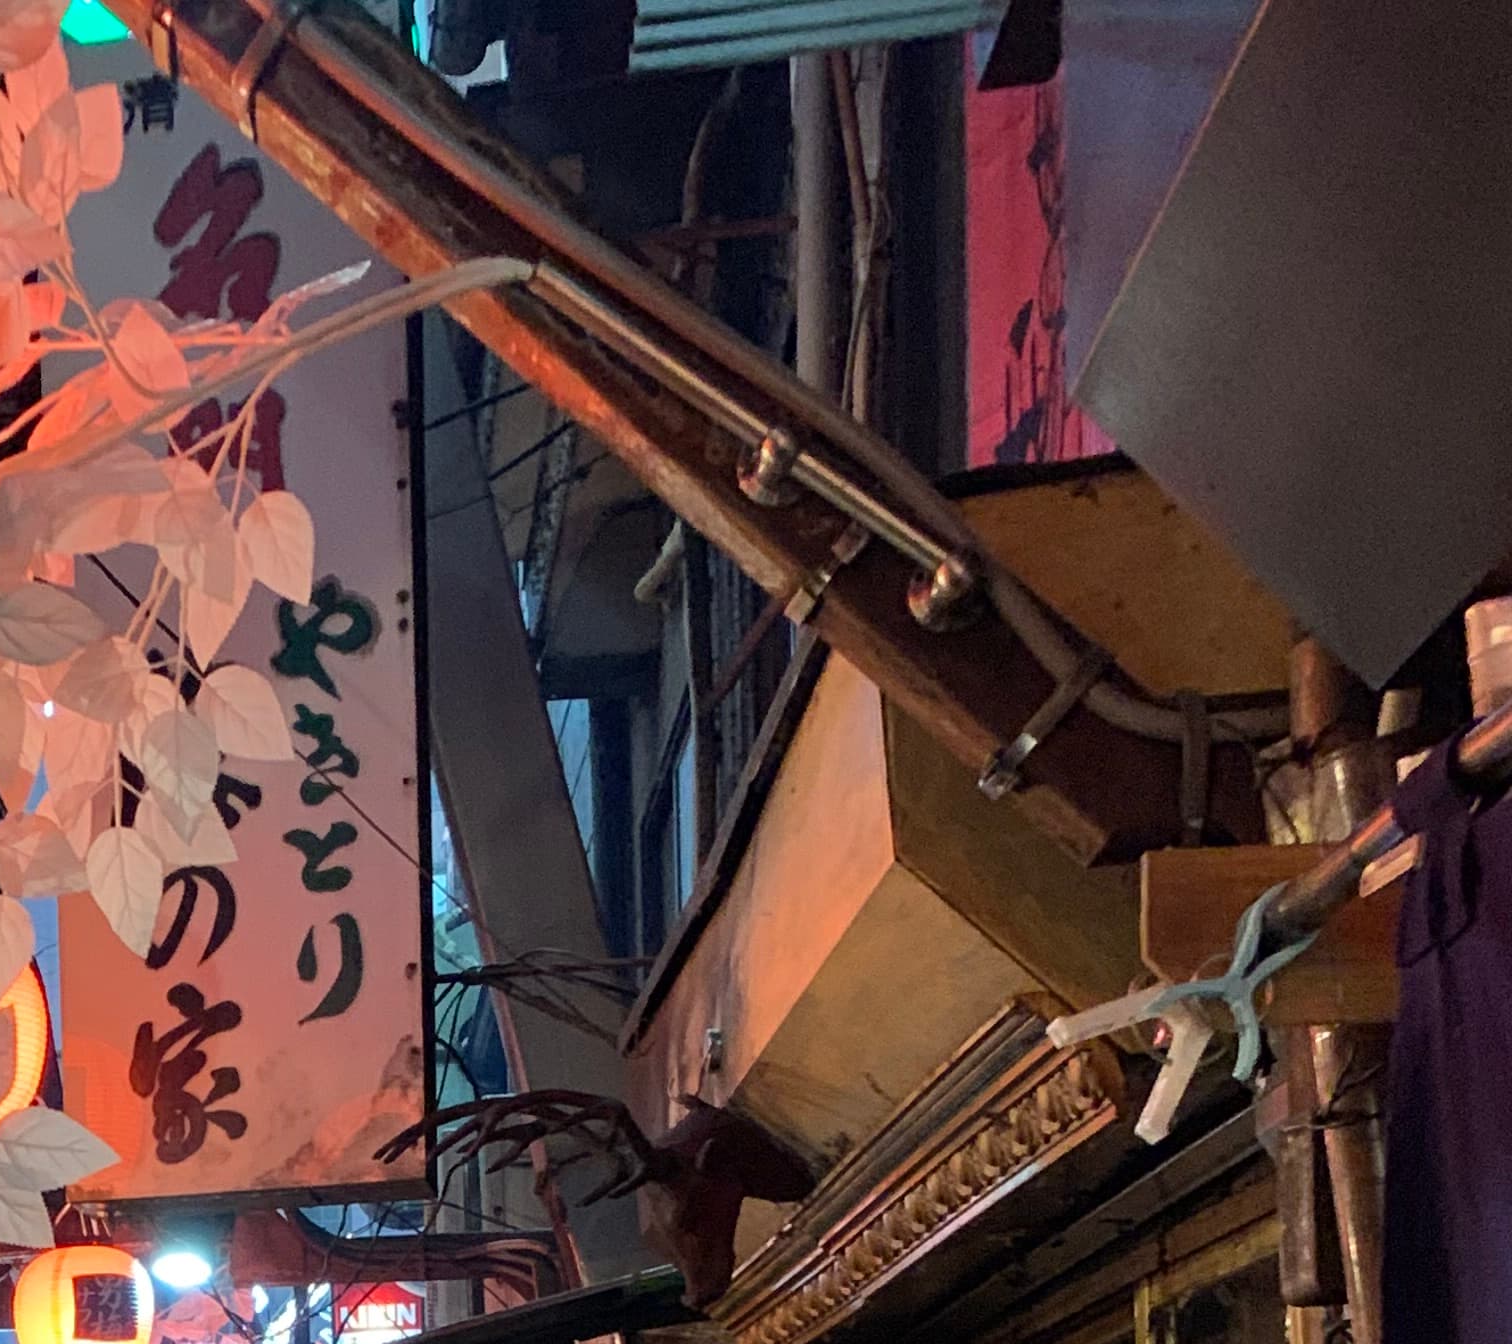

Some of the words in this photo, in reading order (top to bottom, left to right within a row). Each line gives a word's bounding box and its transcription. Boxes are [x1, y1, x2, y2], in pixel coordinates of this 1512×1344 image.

[271, 575, 378, 1026] やきとり
[340, 1303, 416, 1329] KIRIN
